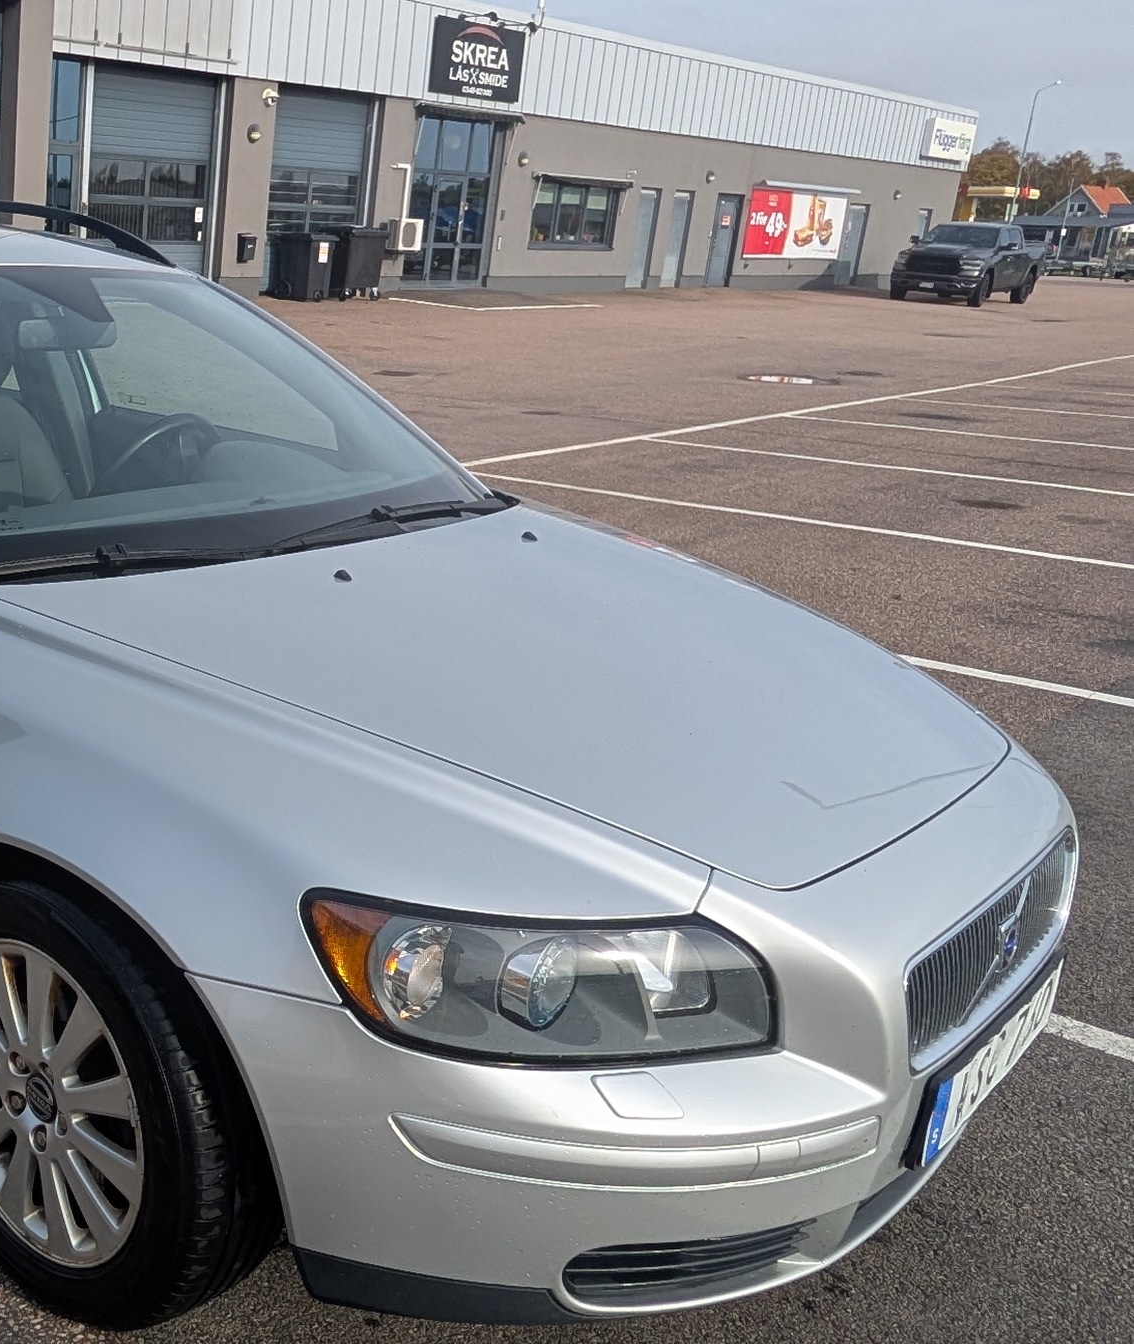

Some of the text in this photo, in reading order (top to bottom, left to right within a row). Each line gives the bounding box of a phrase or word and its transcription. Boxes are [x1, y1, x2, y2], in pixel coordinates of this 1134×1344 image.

[451, 39, 509, 71] SKREA
[449, 65, 509, 88] LÅS SMIDE
[931, 1127, 940, 1145] S
